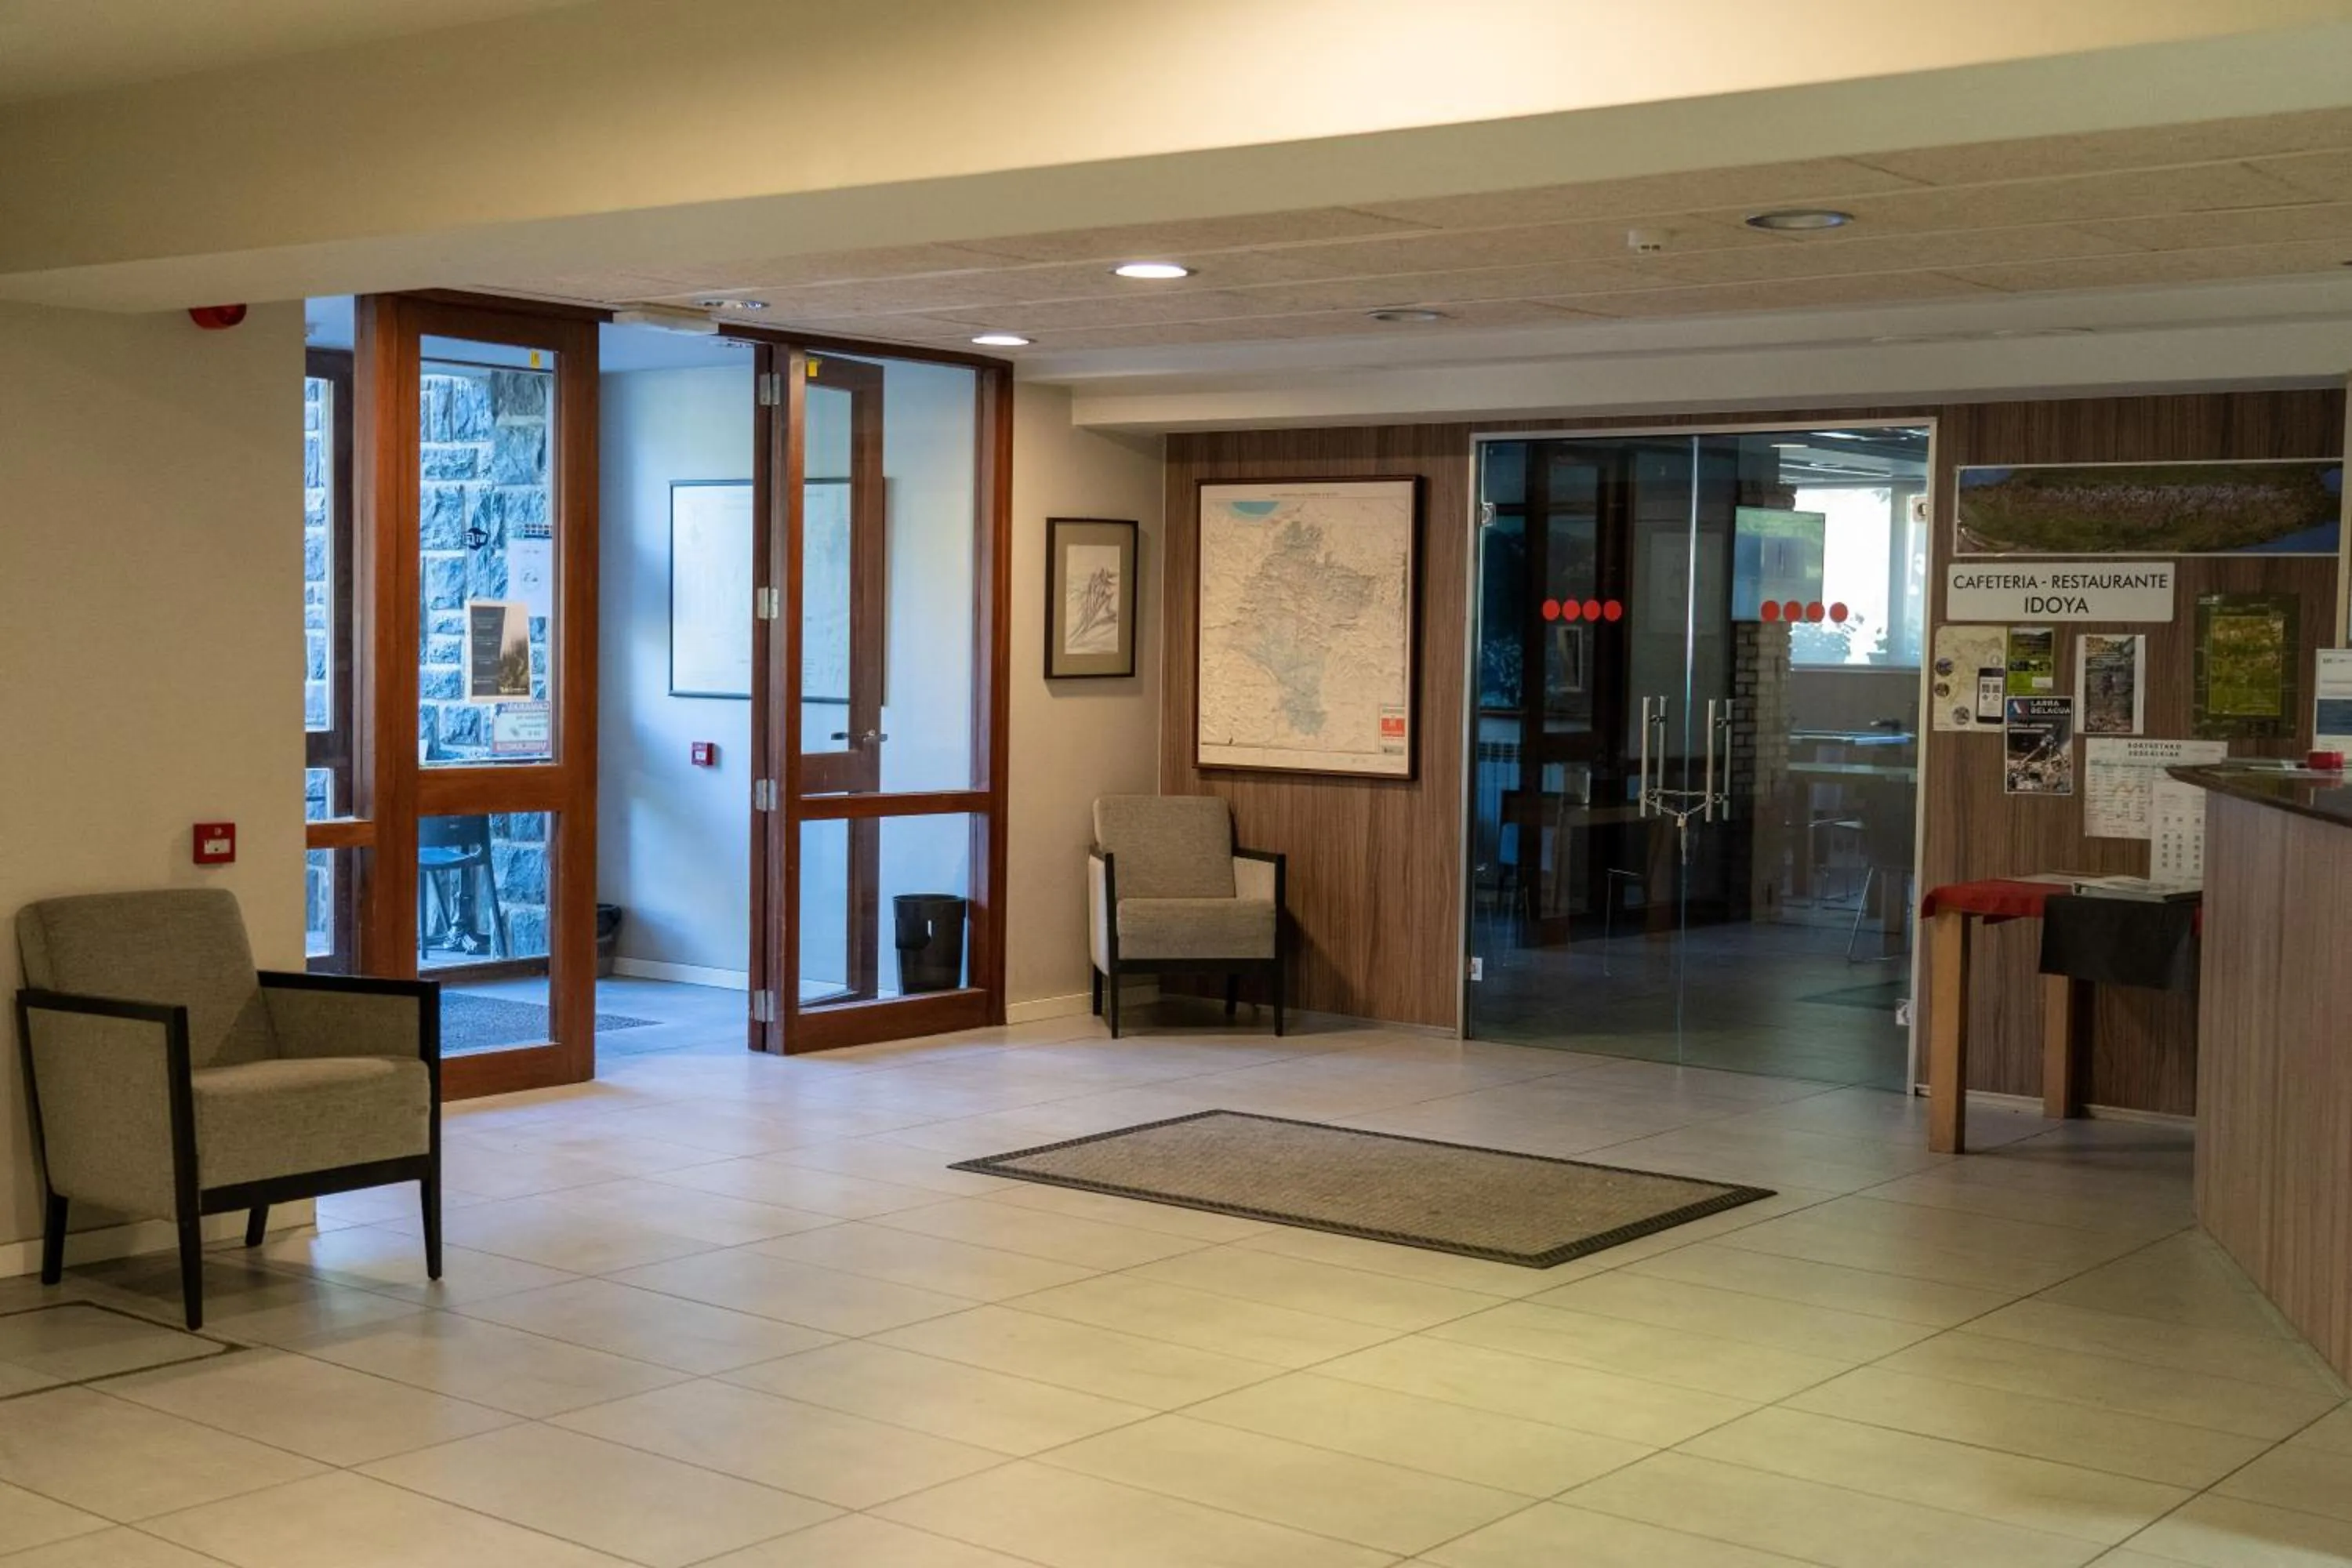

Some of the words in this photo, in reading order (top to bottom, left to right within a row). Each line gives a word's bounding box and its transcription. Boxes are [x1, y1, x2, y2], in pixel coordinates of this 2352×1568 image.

[1953, 574, 2038, 589] CAFETERIA
[2052, 574, 2168, 589] RESTAURANTE
[2024, 597, 2089, 614] IDOYA
